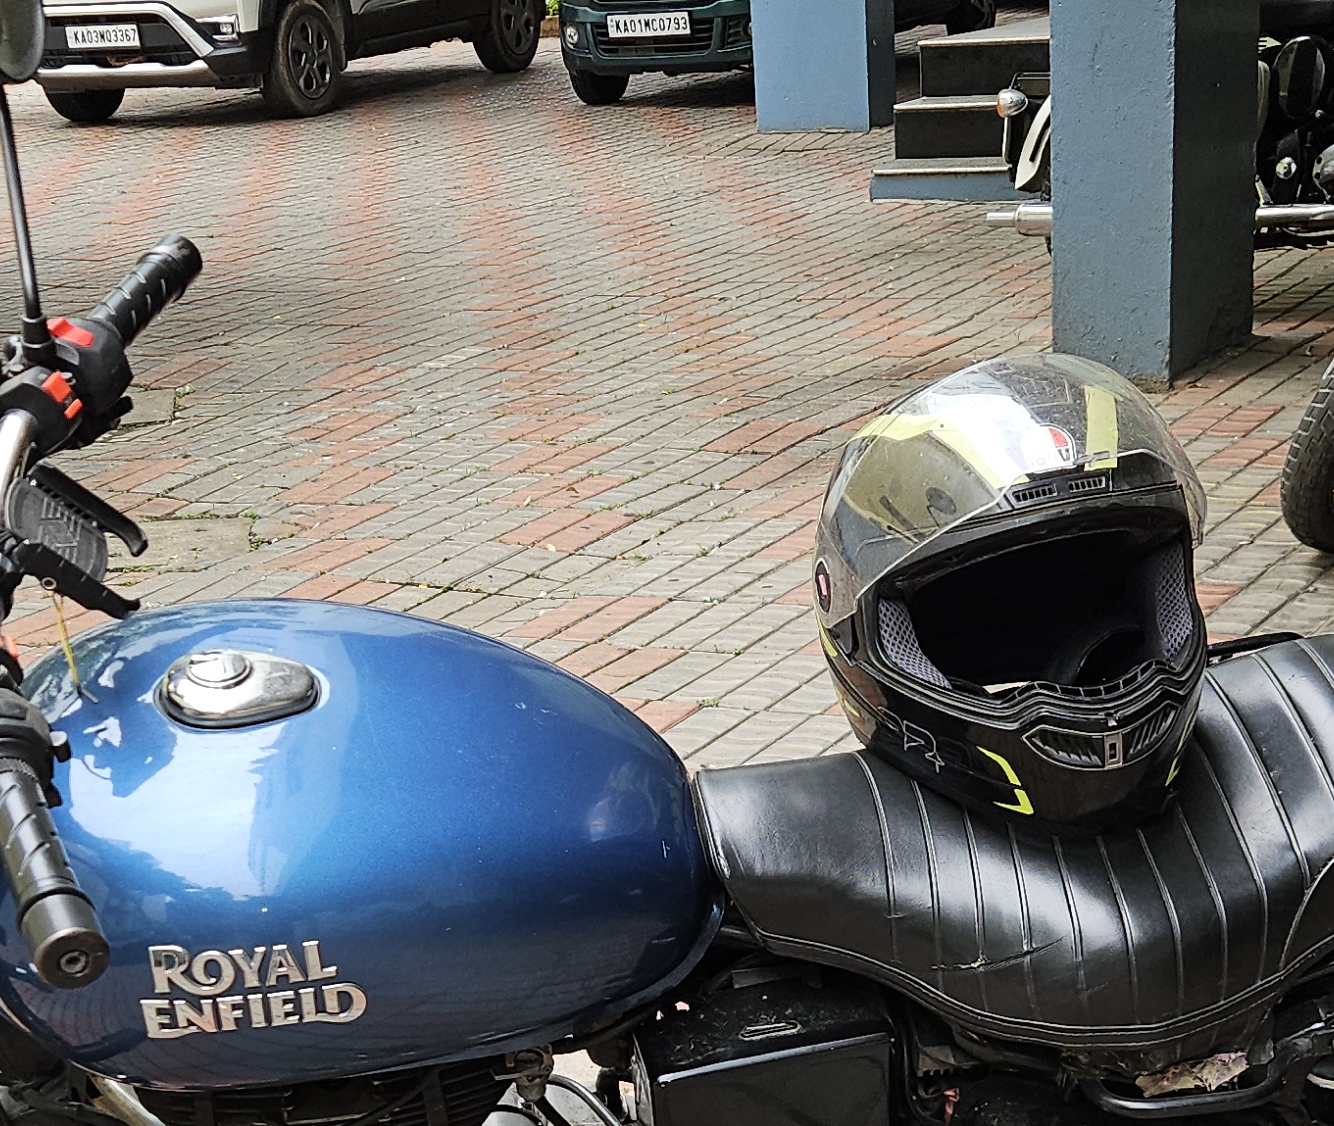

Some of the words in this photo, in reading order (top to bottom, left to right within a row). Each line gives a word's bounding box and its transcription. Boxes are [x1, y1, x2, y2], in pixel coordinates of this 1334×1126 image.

[615, 16, 688, 34] KA01MC0793
[148, 940, 338, 997] ROYAL
[139, 982, 367, 1039] ENFIELD
